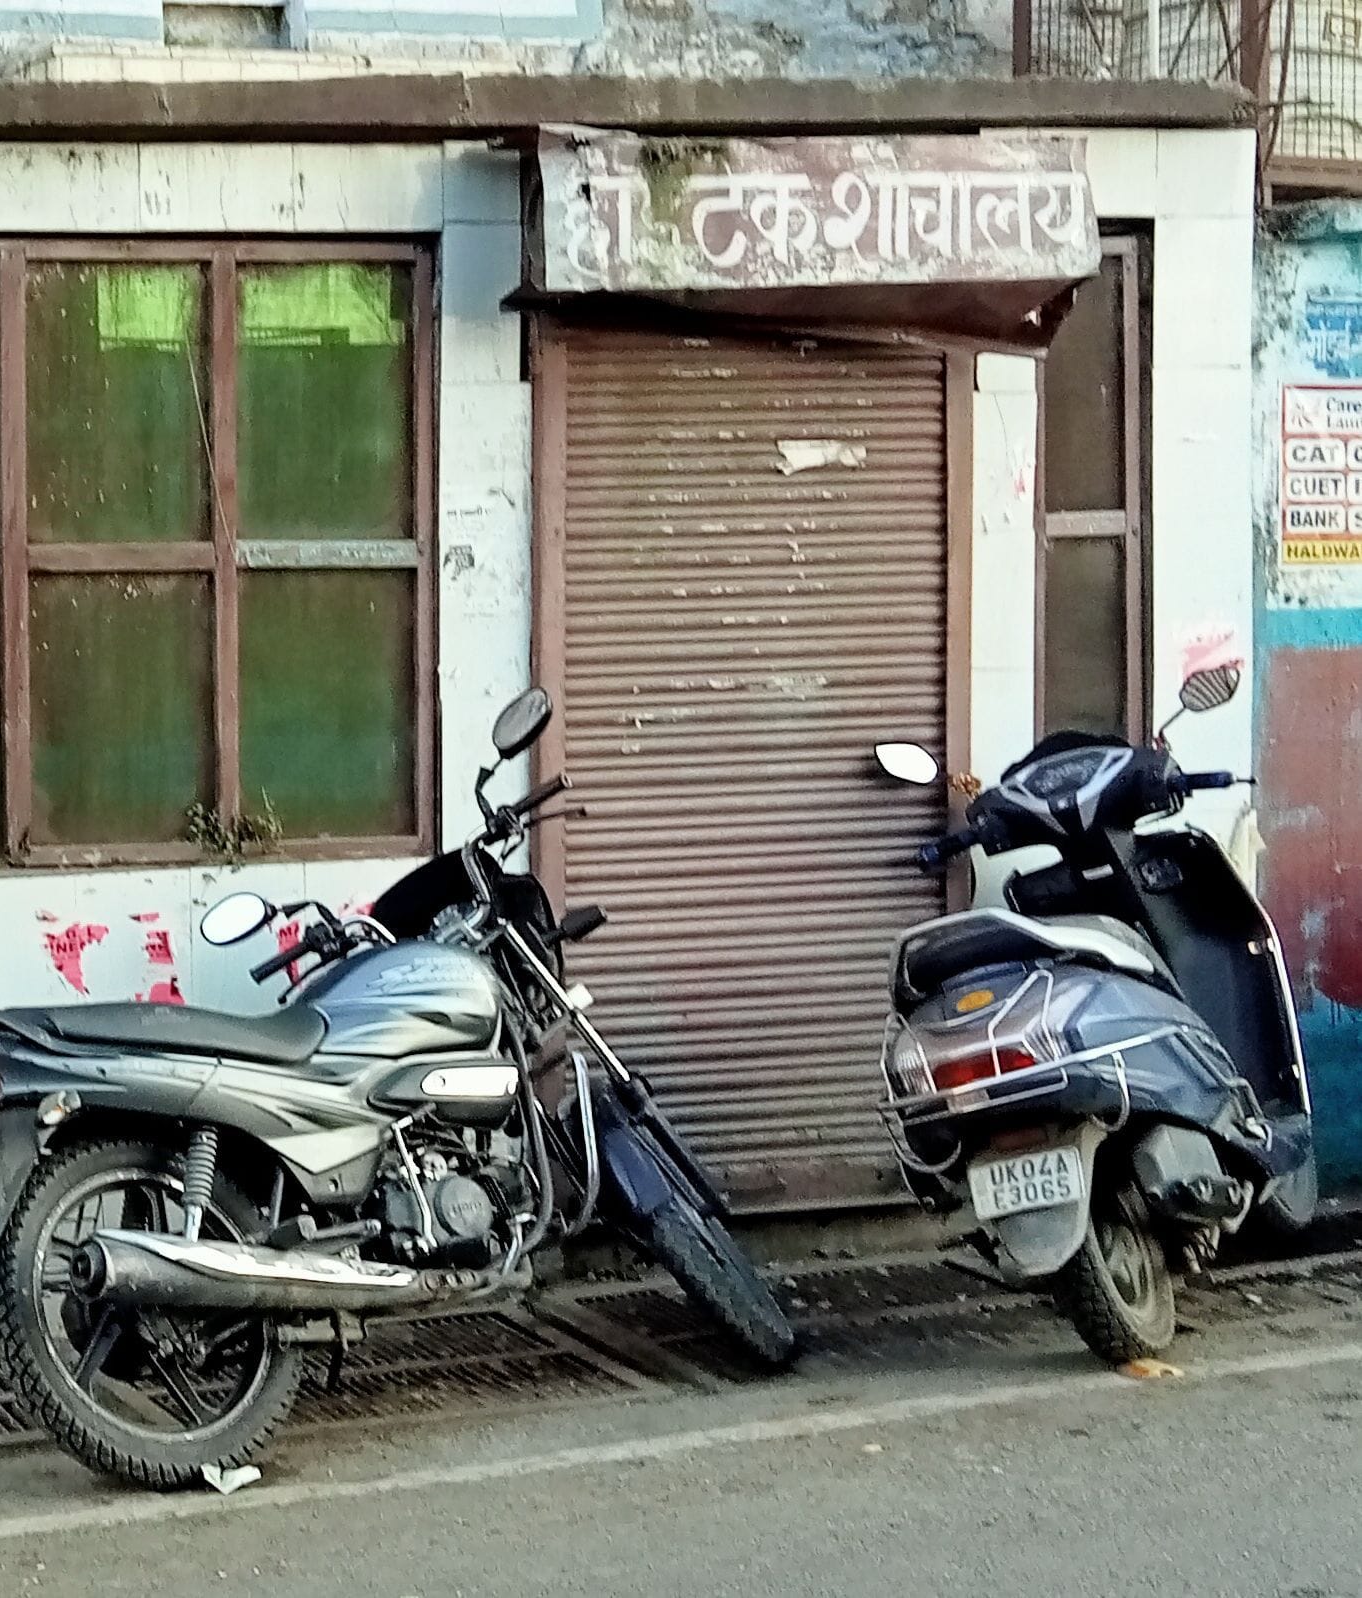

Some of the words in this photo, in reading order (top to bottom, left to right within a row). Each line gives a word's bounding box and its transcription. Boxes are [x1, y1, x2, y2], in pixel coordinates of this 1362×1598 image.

[1291, 445, 1339, 464] CAT
[1290, 477, 1341, 496] CUET
[1291, 510, 1340, 528] BANK
[989, 1152, 1069, 1186] UK04A
